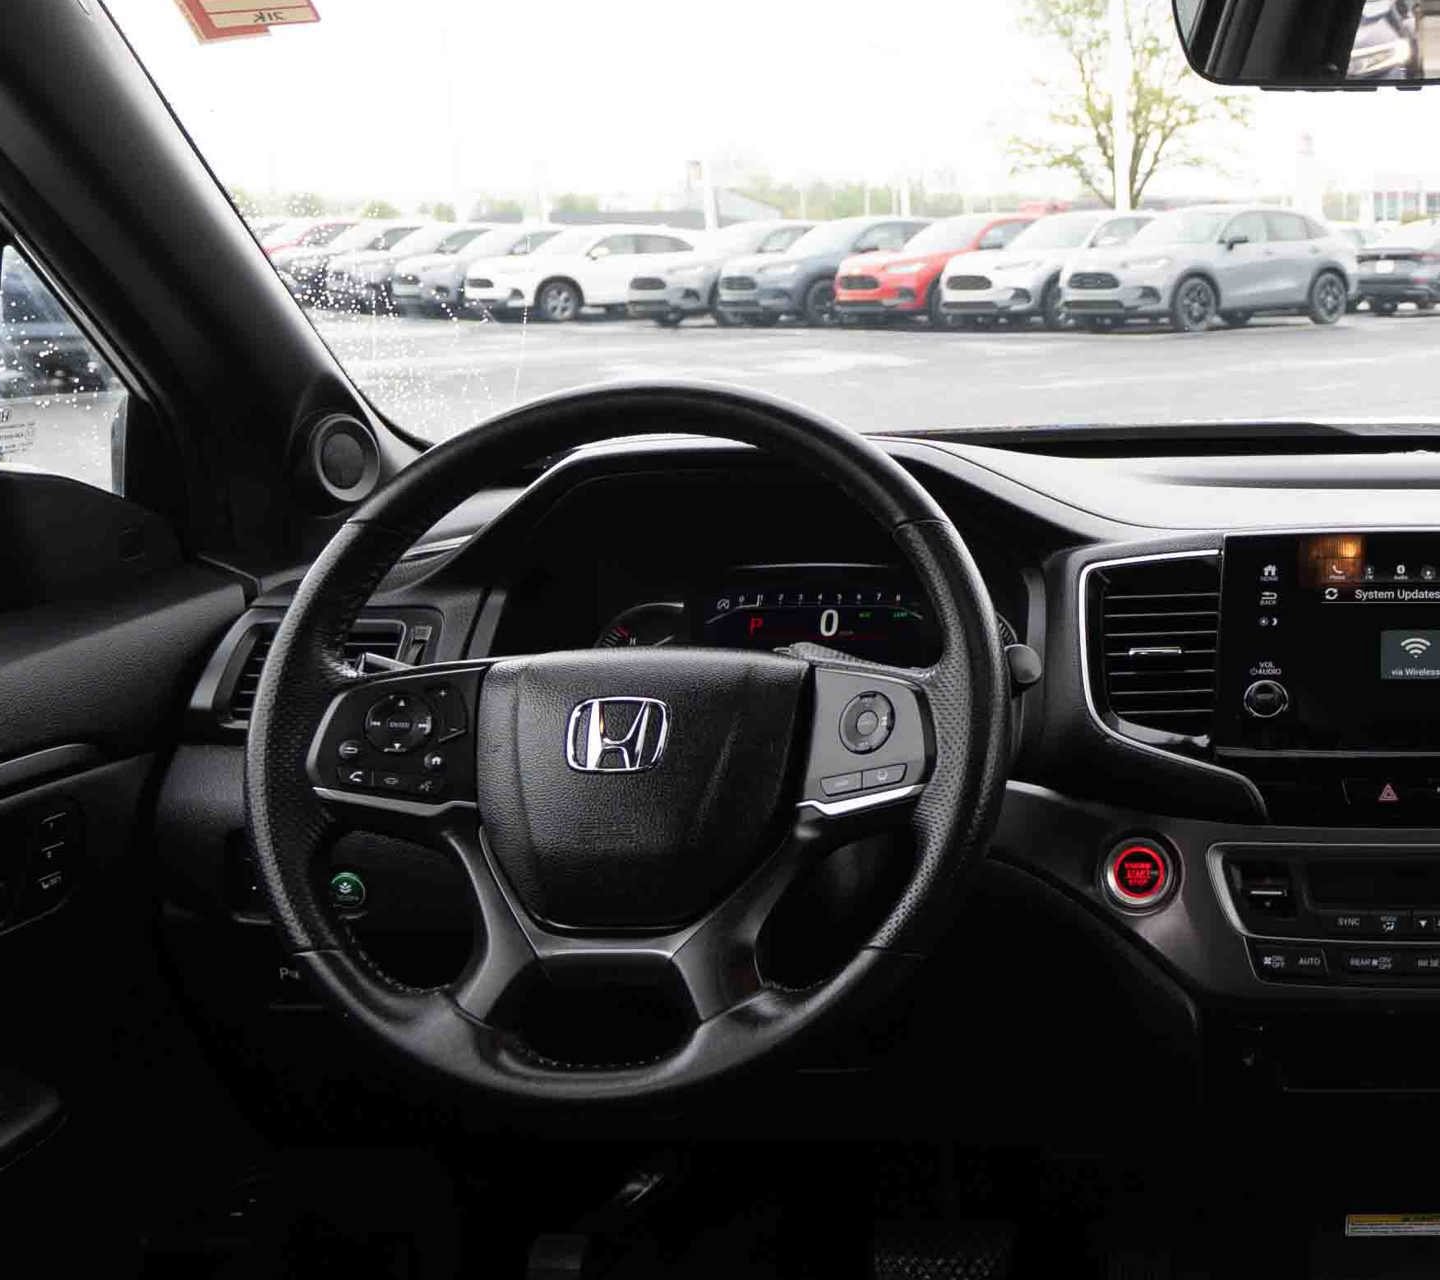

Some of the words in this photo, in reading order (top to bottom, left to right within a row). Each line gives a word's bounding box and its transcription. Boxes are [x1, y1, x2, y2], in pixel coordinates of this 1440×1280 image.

[1354, 590, 1396, 601] System
[1397, 589, 1440, 601] Updates
[749, 617, 763, 637] P
[820, 609, 839, 637] 0
[1391, 668, 1403, 676] via
[1404, 668, 1440, 676] Wireless
[1337, 918, 1360, 927] SYNC
[1298, 958, 1320, 966] AUTO
